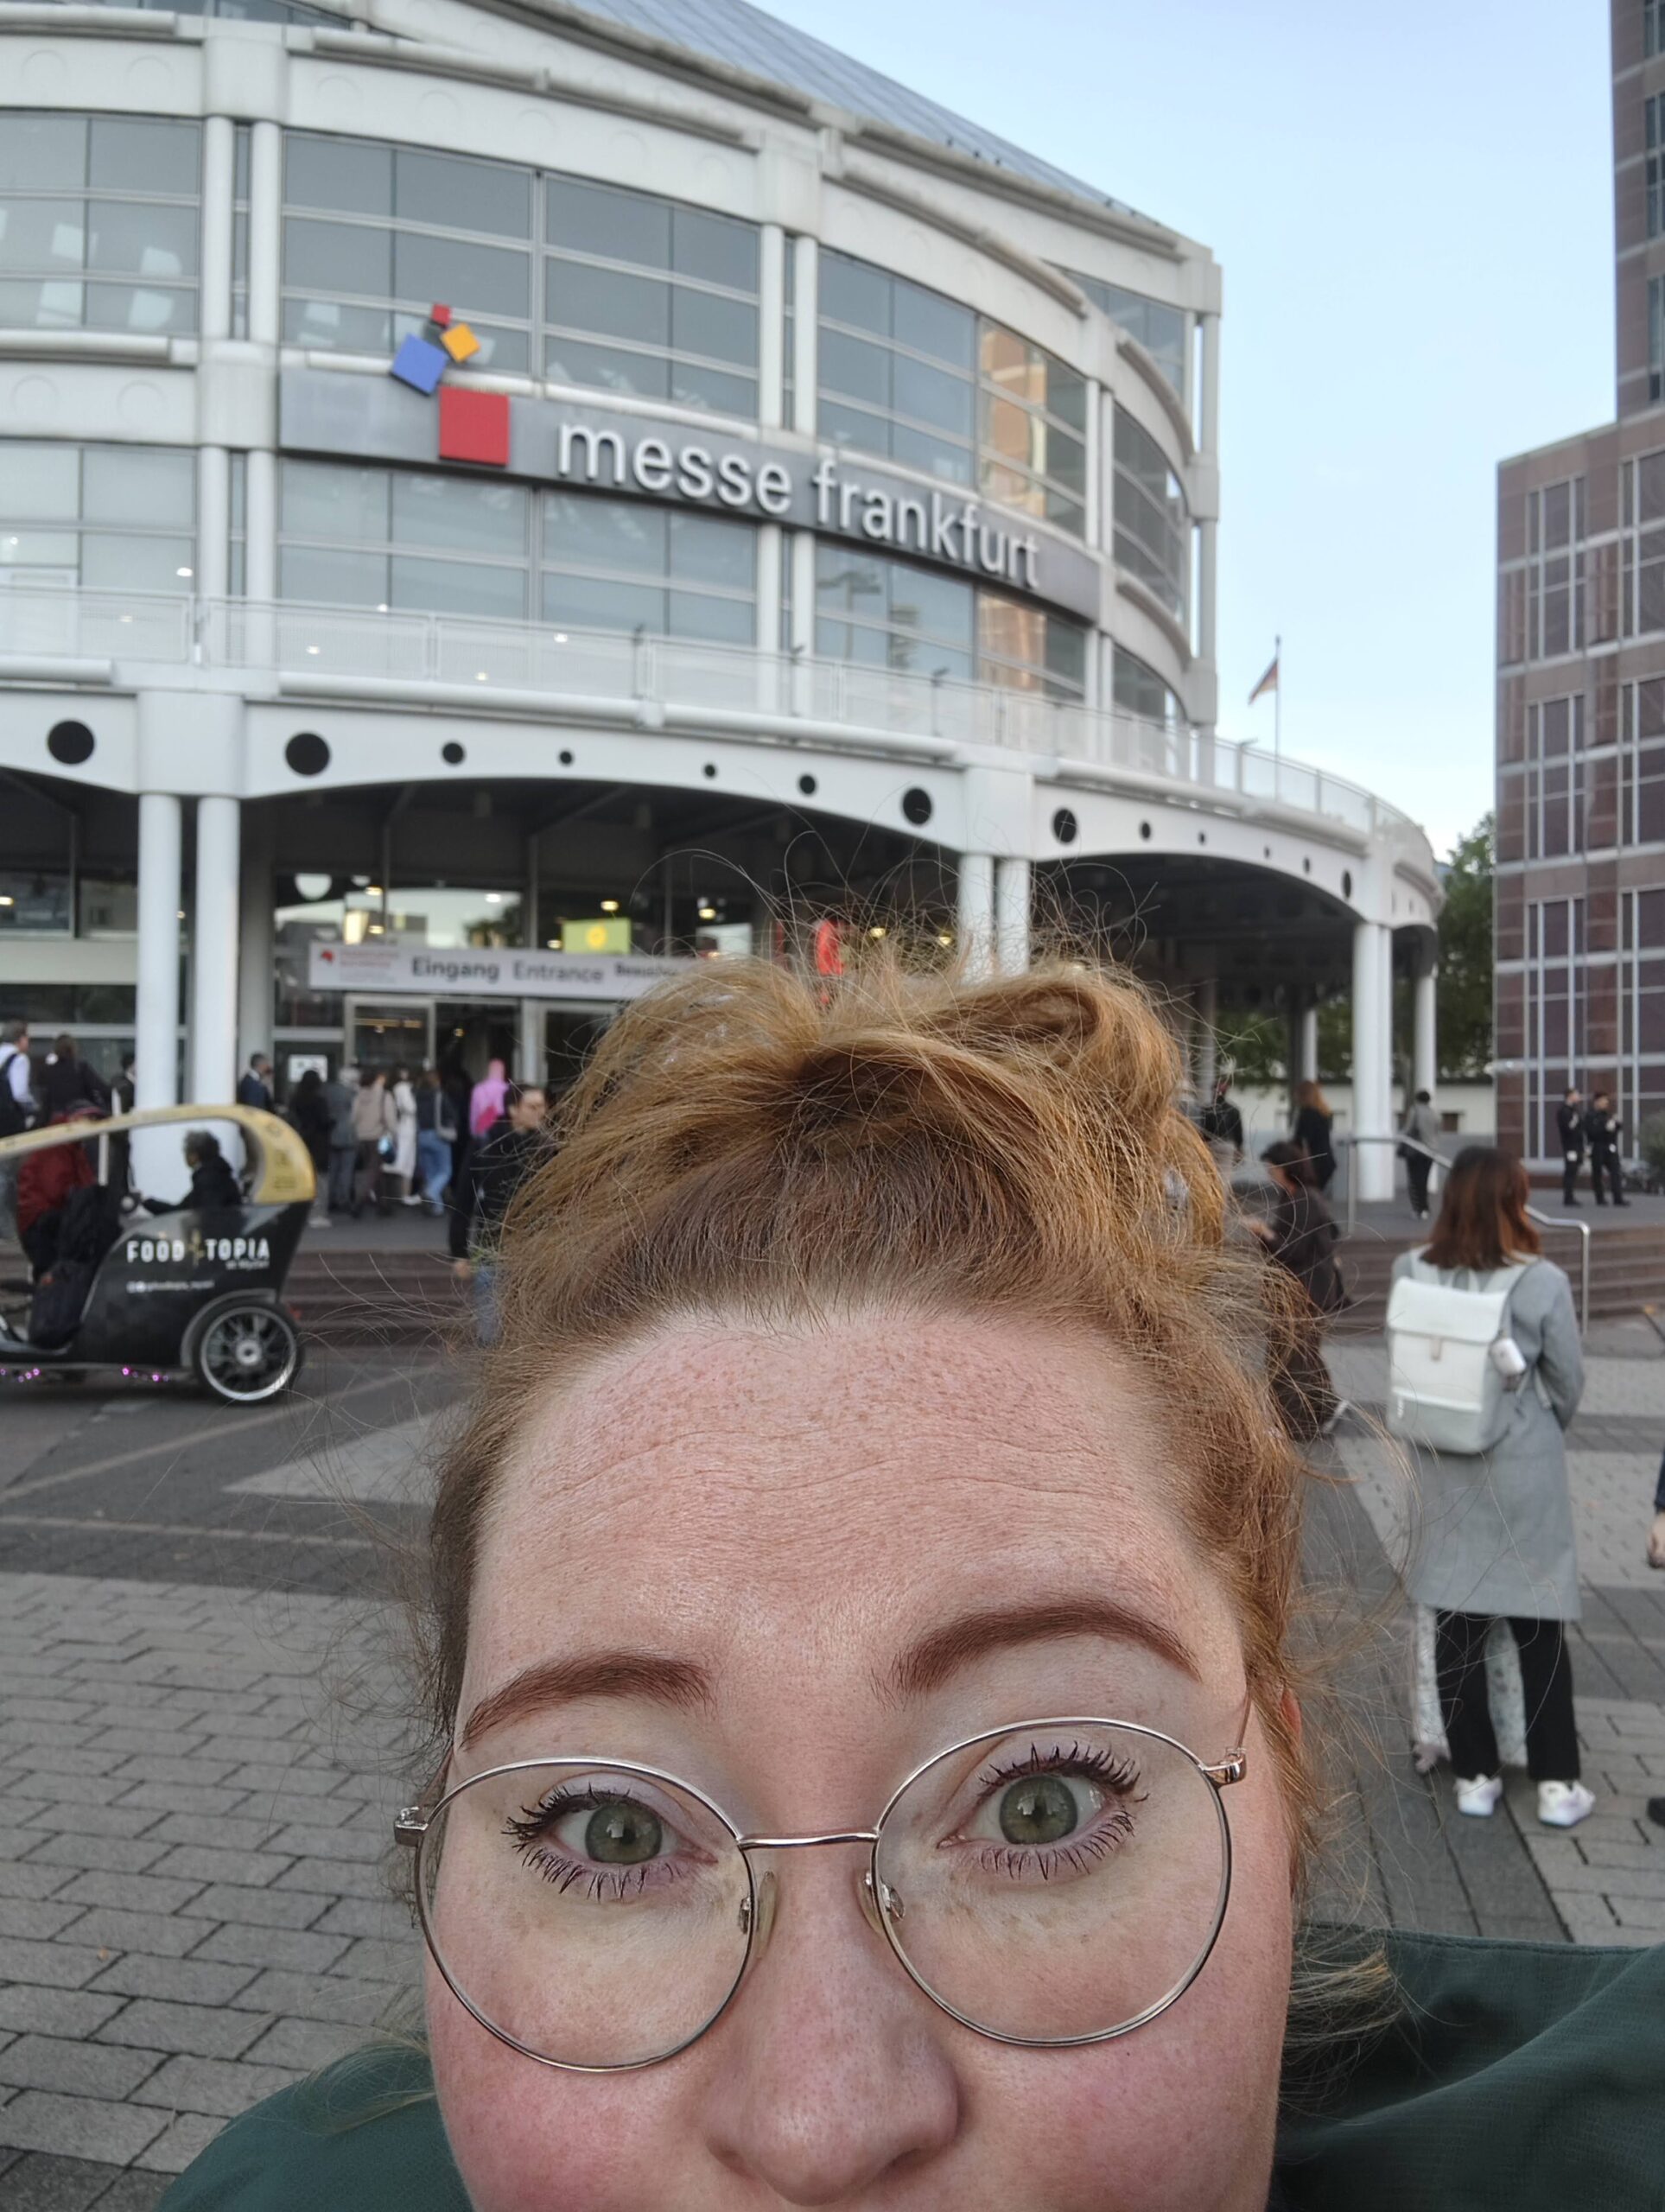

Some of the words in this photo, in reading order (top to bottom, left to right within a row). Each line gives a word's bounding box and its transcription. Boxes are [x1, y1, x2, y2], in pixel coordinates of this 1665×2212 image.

[557, 423, 792, 514] messe
[812, 459, 1039, 589] frankfurt
[411, 957, 499, 982] Eingang
[513, 962, 603, 983] Entrance
[127, 1239, 186, 1263] FOOD
[205, 1237, 270, 1262] TOPIA
